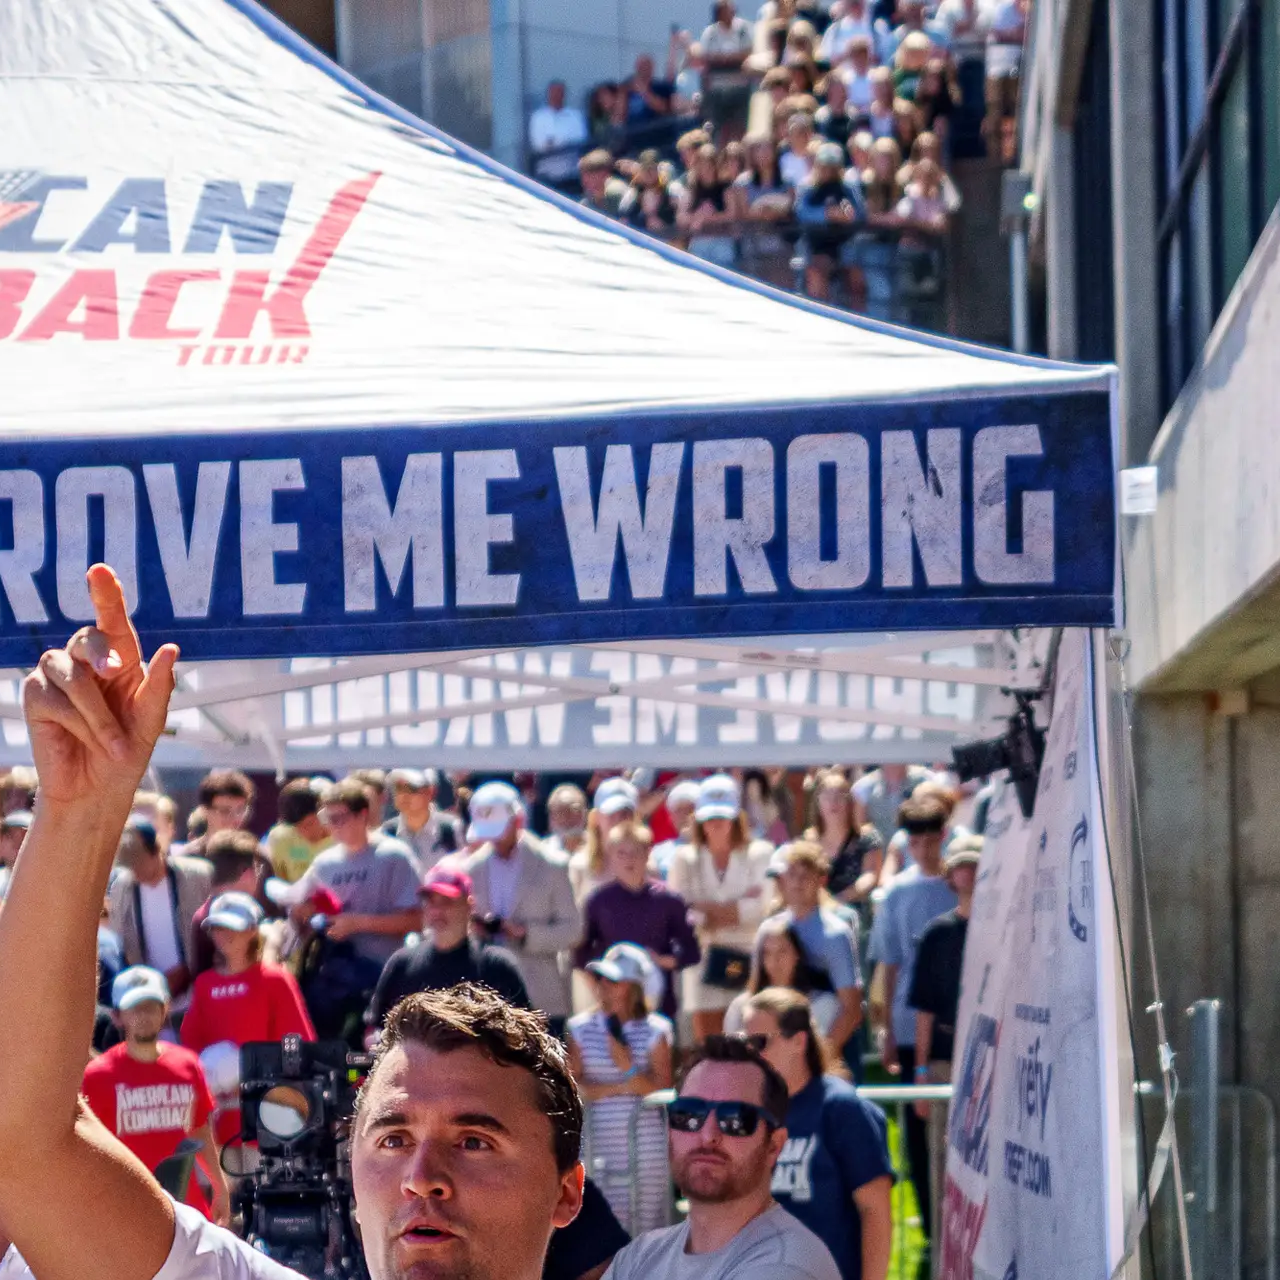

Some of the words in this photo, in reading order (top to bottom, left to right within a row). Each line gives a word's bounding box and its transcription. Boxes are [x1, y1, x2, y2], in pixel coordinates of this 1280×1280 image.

[176, 344, 311, 367] TOUR
[341, 450, 522, 611] ME
[552, 424, 1056, 602] WRONG
